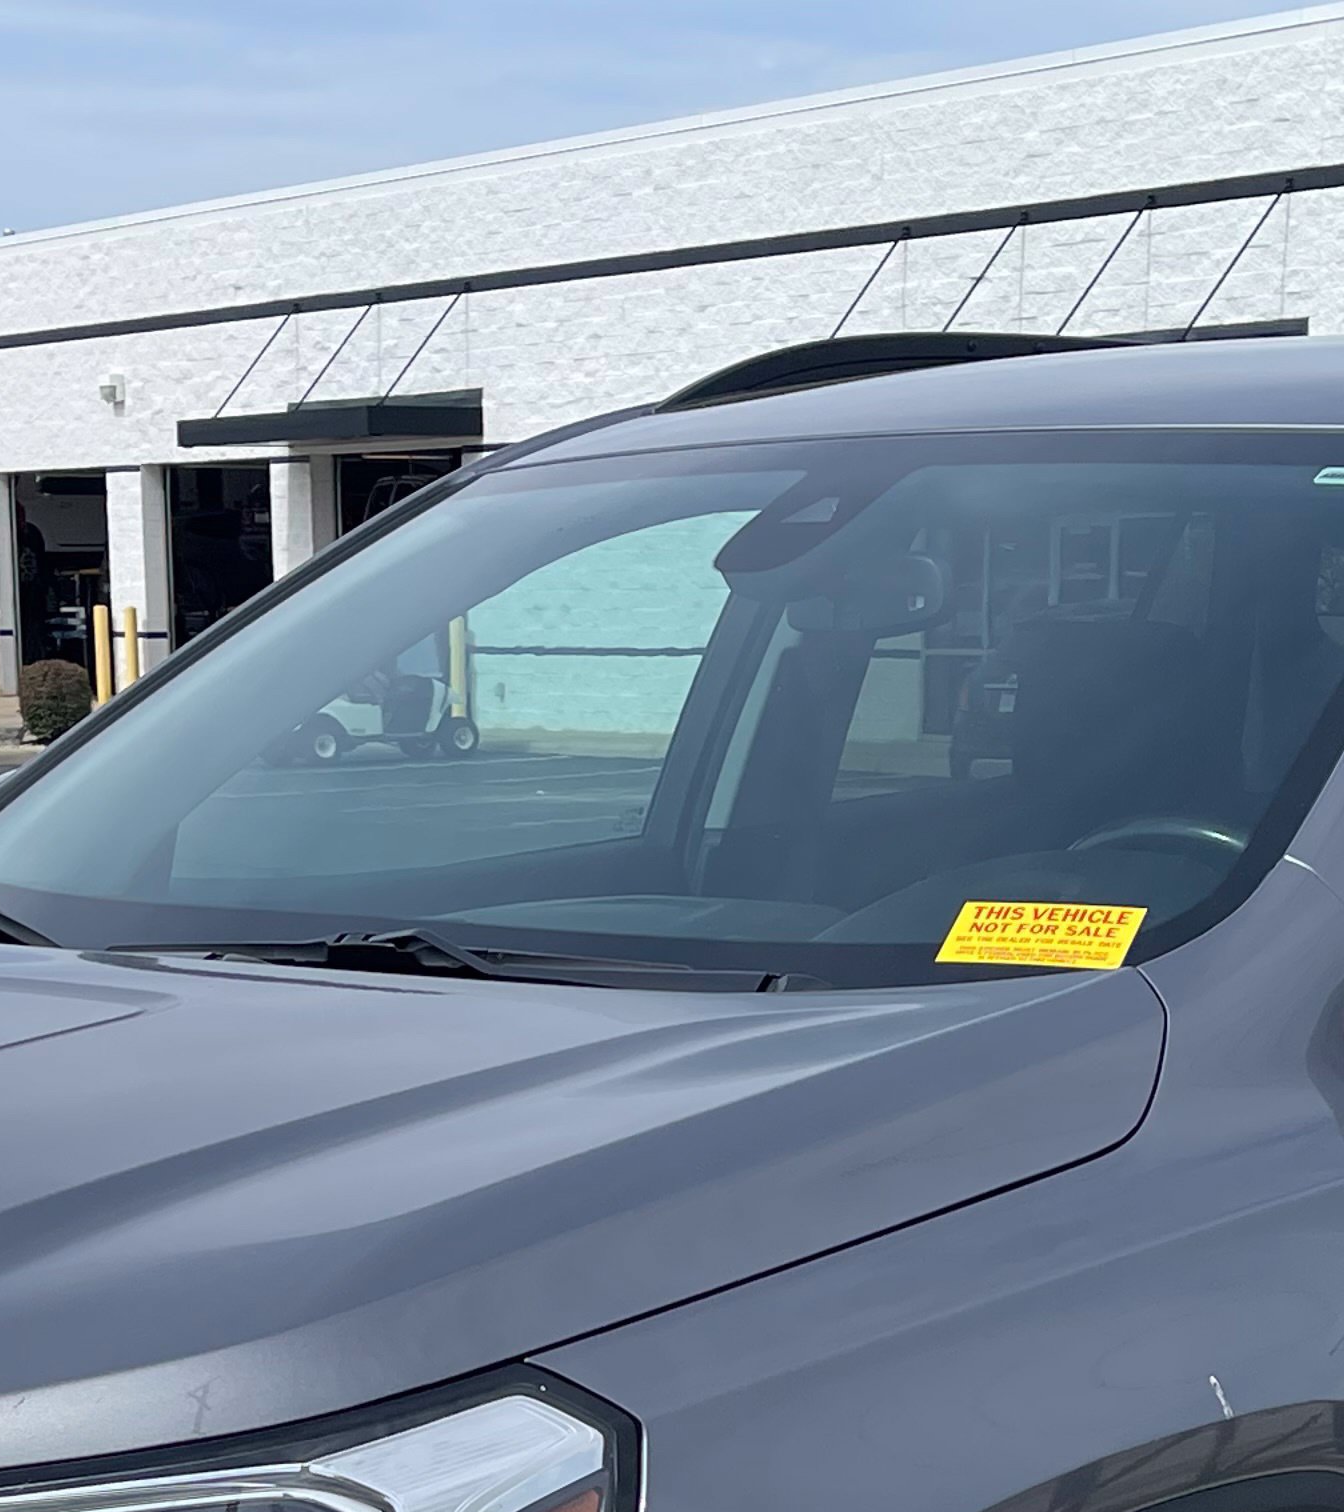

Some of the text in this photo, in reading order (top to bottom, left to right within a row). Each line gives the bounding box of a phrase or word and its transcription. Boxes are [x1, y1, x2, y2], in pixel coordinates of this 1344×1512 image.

[973, 905, 1135, 926] THIS VEHICLE
[968, 921, 1120, 939] NOT FOR SALE
